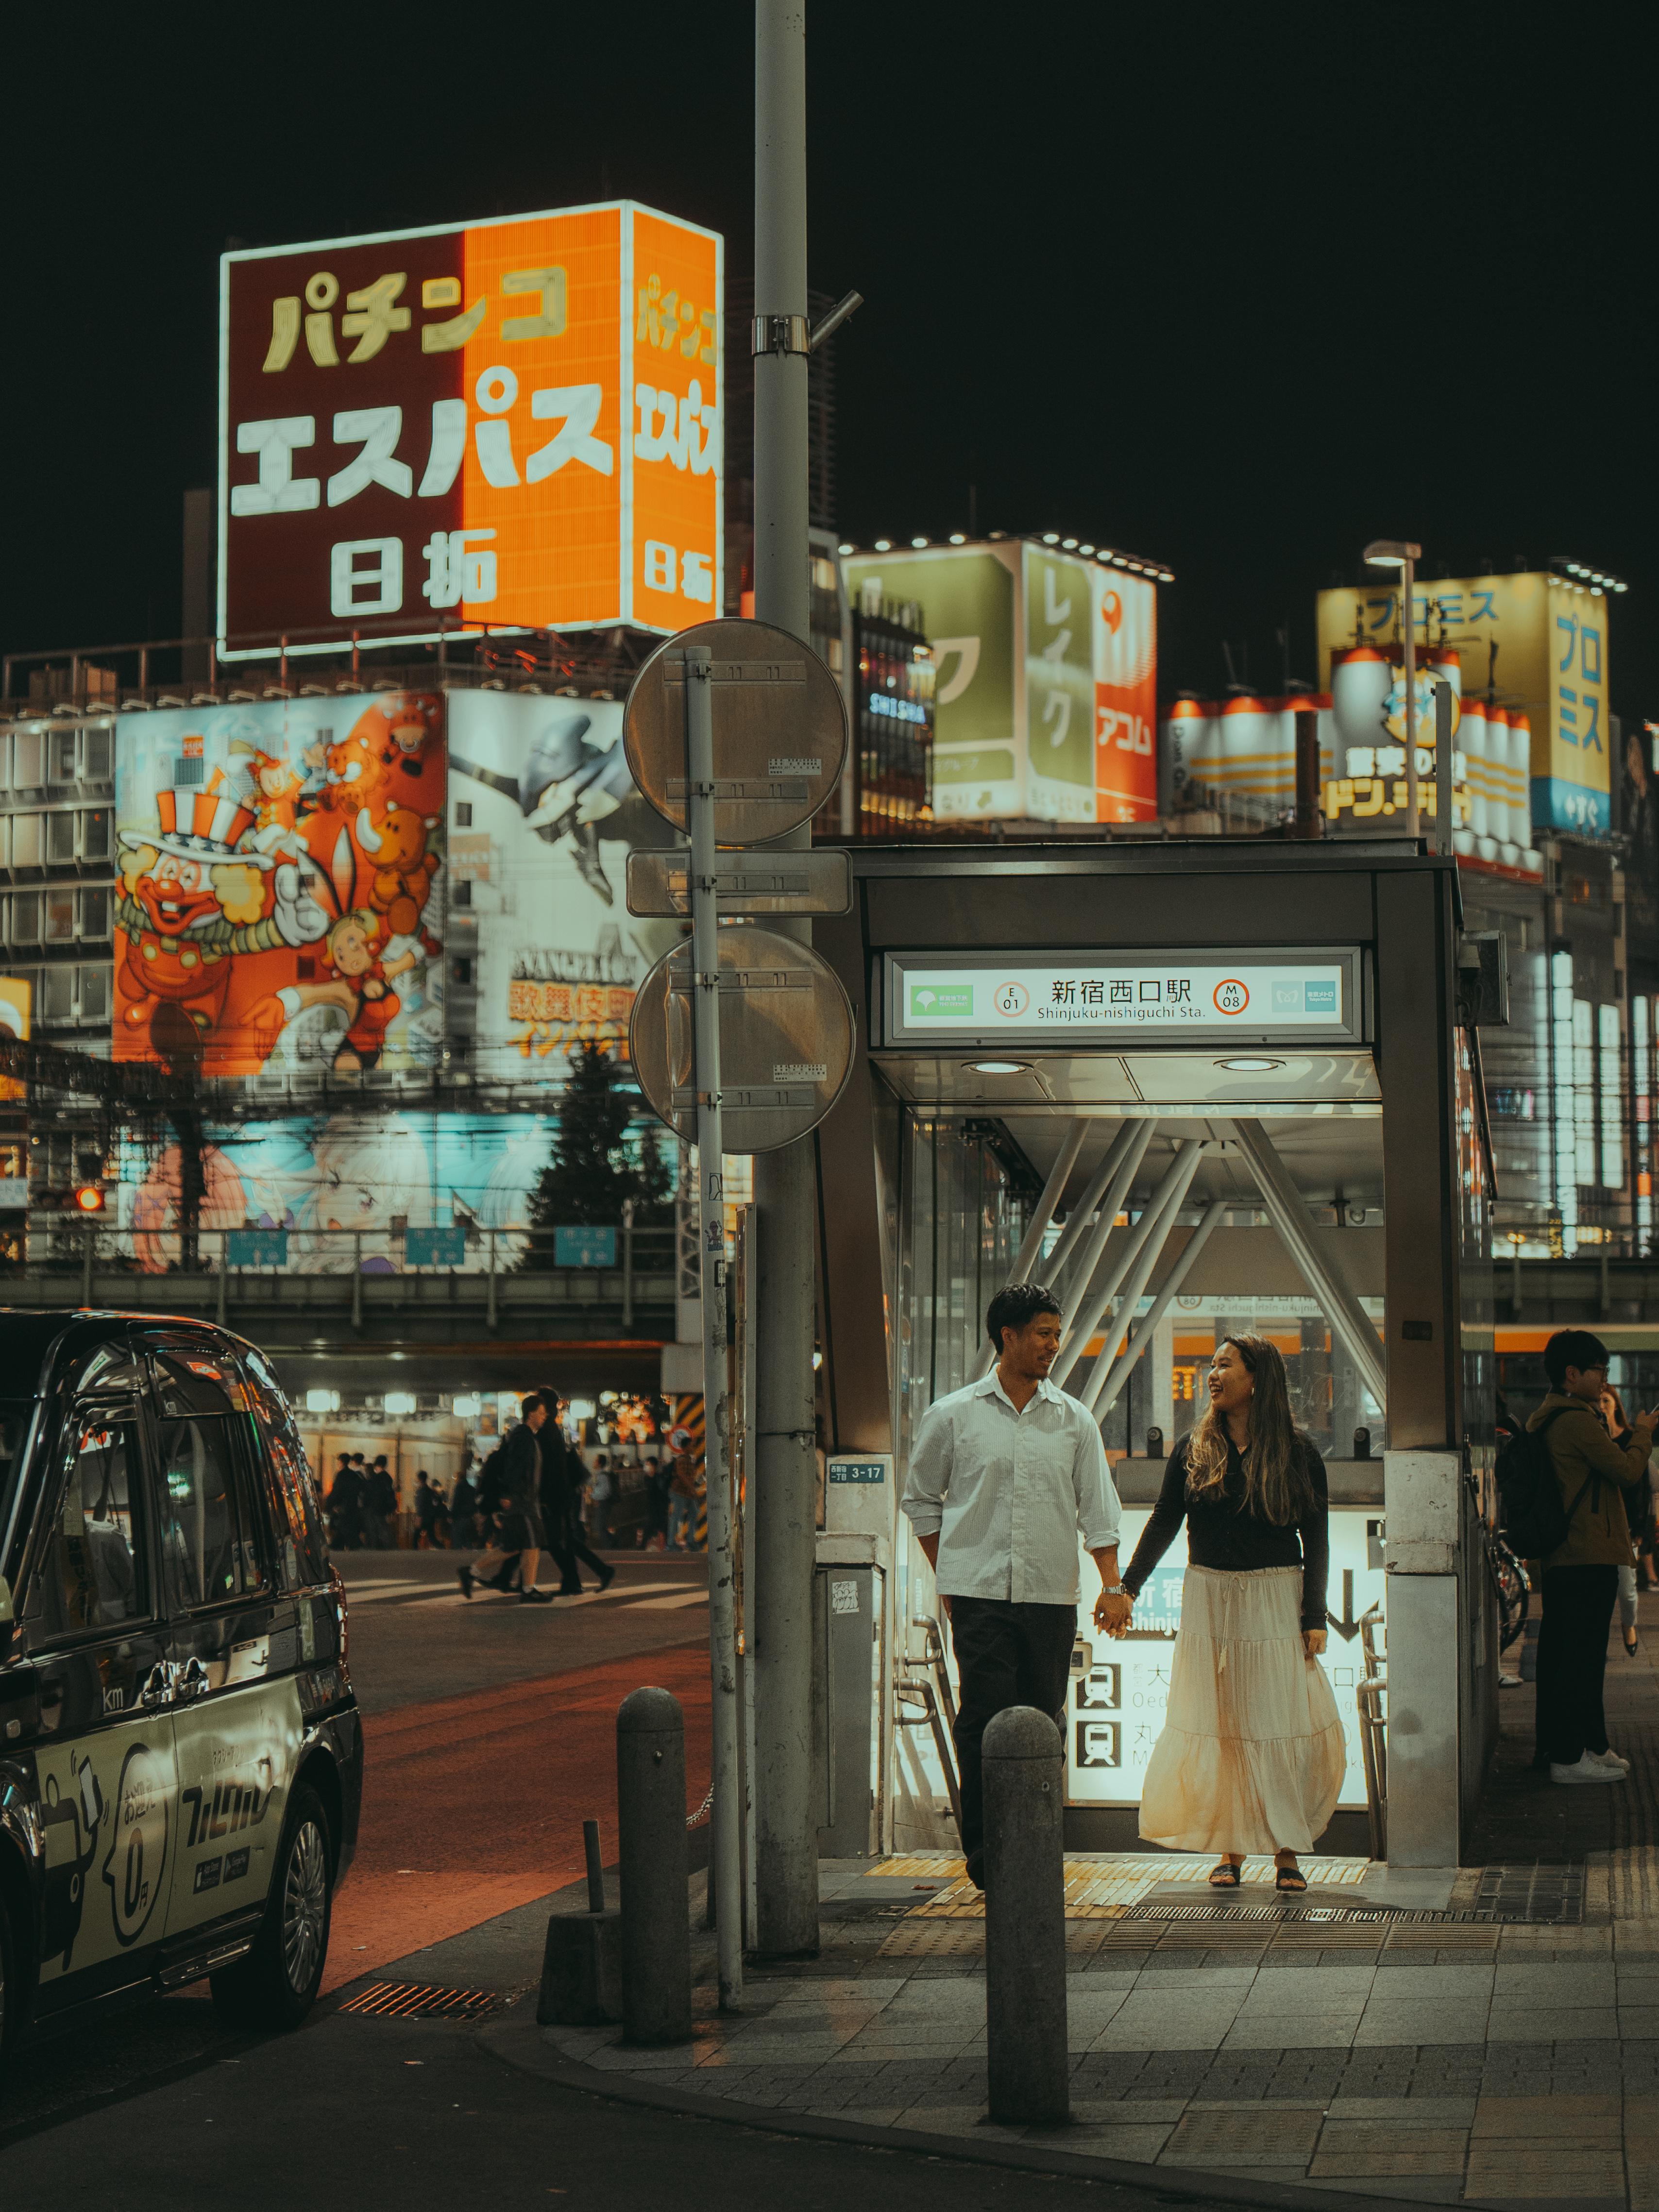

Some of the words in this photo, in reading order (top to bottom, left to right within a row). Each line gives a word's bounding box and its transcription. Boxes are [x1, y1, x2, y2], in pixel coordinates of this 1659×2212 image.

[263, 266, 567, 372] パチンコ
[636, 273, 716, 367] パチンコ
[231, 365, 613, 516] エスパス
[634, 379, 720, 478] エスパス
[331, 528, 497, 617] 日拓
[644, 540, 712, 603] 日拓
[1043, 566, 1071, 749] レイク
[869, 692, 926, 724] SHISHA
[1098, 707, 1152, 757] アコム
[1003, 999, 1018, 1009] 01
[1009, 988, 1015, 996] E
[1051, 980, 1191, 1004] 新宿西口駅
[1223, 997, 1239, 1007] 08
[1226, 986, 1236, 995] M
[1038, 1006, 1174, 1021] Shinjuku-nishiguchi
[1180, 1007, 1206, 1018] Sta.
[852, 1468, 880, 1478] 3-17
[103, 1686, 124, 1709] km
[1133, 1692, 1167, 1708] Oed
